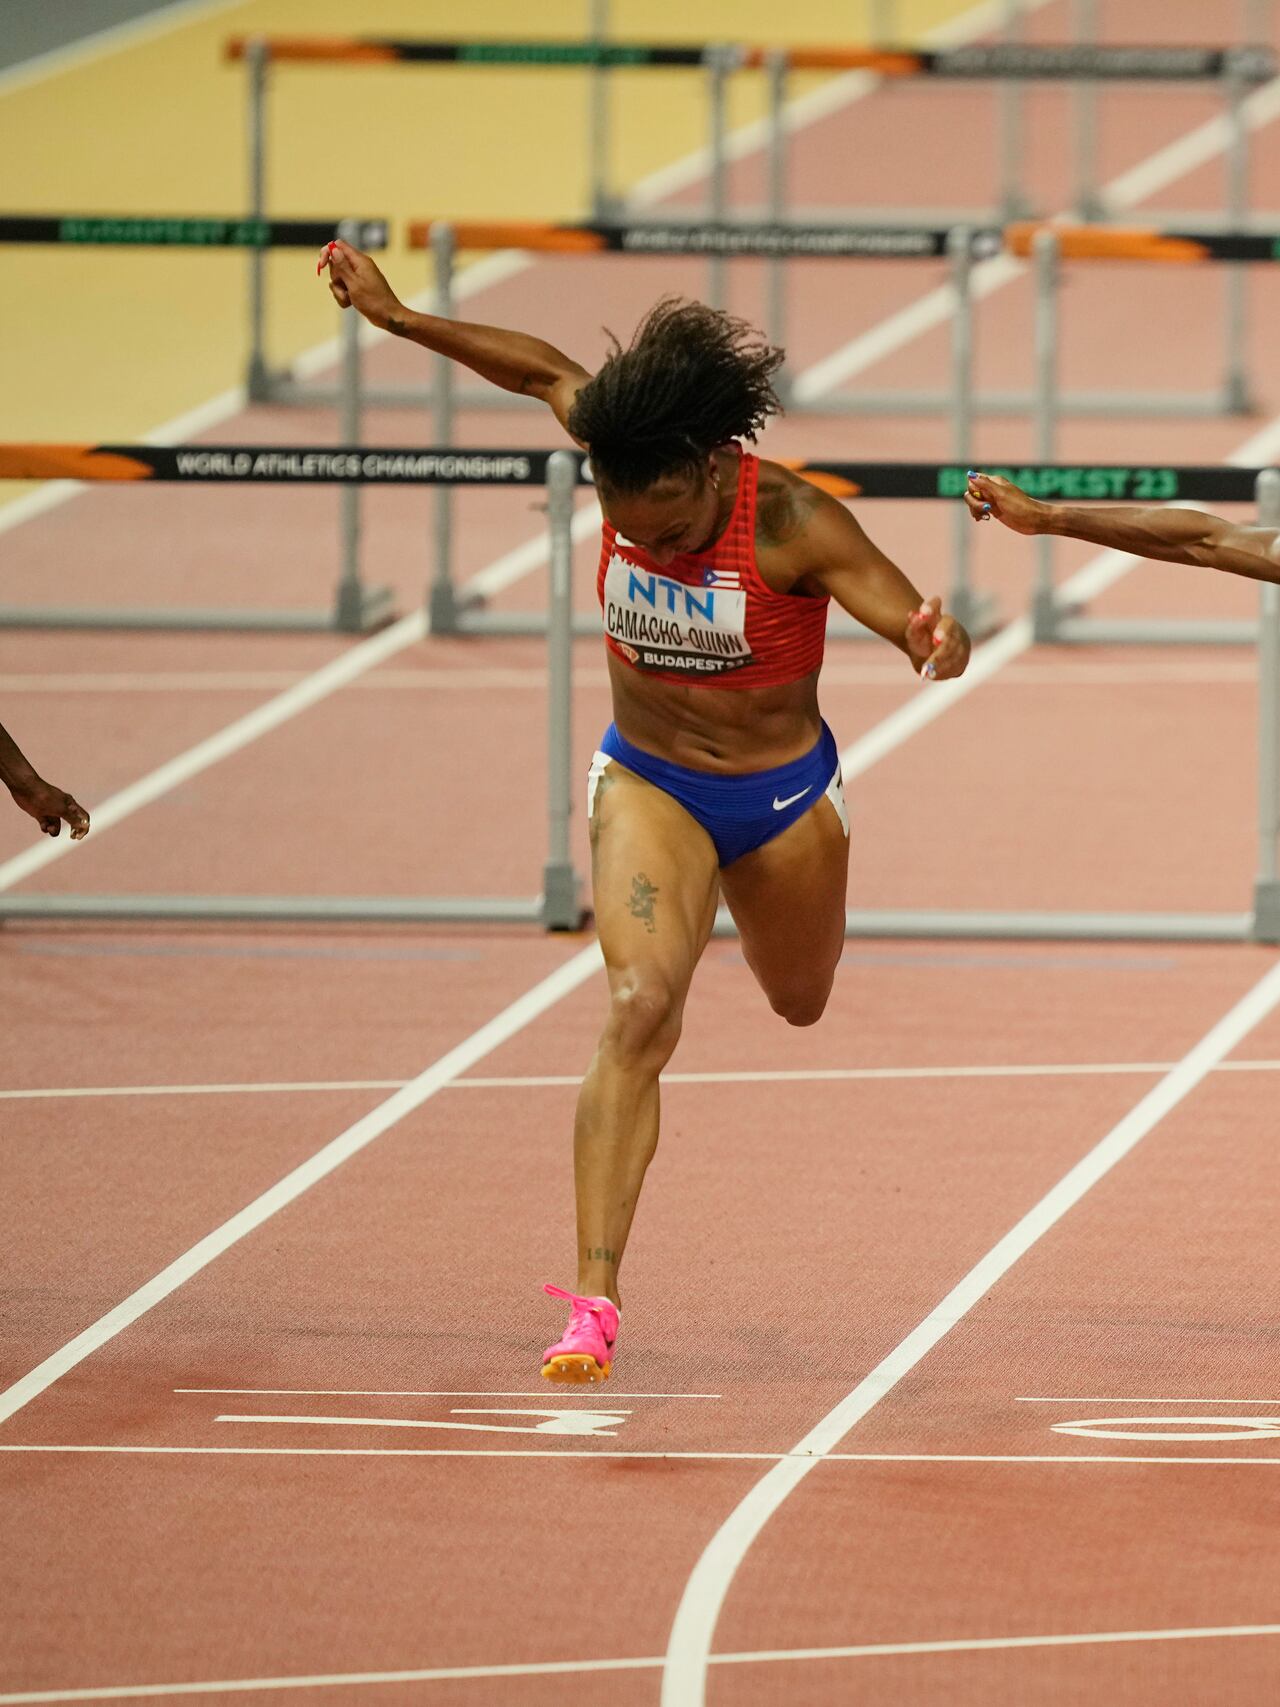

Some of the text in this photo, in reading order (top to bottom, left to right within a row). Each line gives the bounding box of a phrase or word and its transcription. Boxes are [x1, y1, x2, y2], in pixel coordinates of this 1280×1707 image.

[176, 452, 531, 479] WORLD ATHLETICS CHAMPIONSHIPS
[1132, 468, 1178, 499] 23
[628, 570, 714, 624] NTN
[607, 602, 743, 654] CAMACHO-QUINN
[644, 652, 724, 671] BUDAPEST
